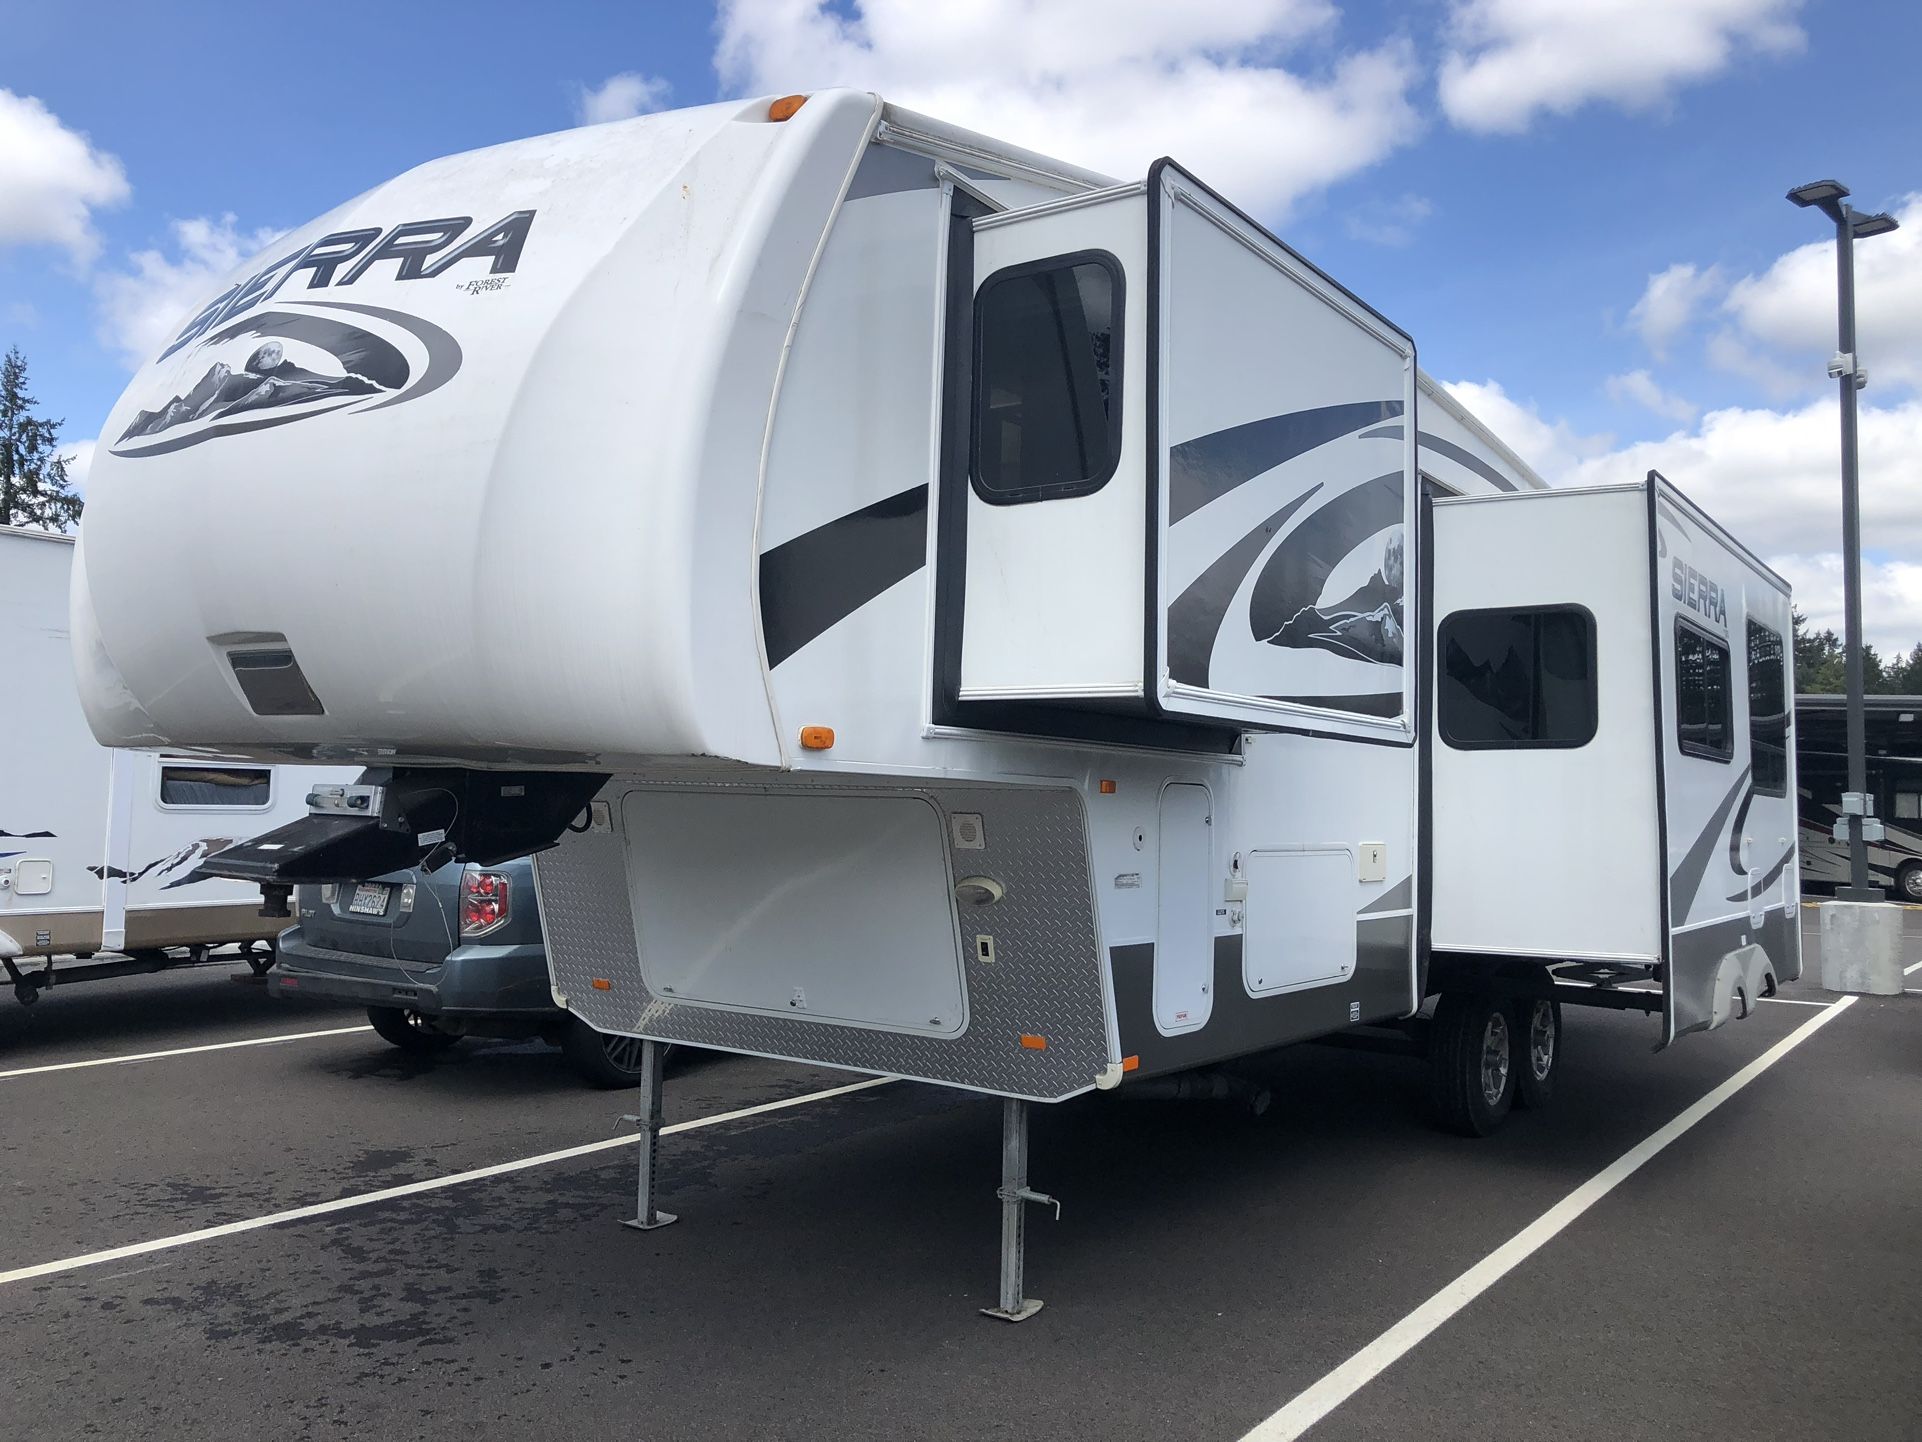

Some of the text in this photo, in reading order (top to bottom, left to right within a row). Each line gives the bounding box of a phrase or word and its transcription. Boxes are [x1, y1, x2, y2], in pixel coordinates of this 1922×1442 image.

[156, 209, 537, 364] SIERRA
[466, 276, 509, 291] FOREST
[470, 284, 503, 295] RIVER
[1671, 555, 1728, 628] SIERRA
